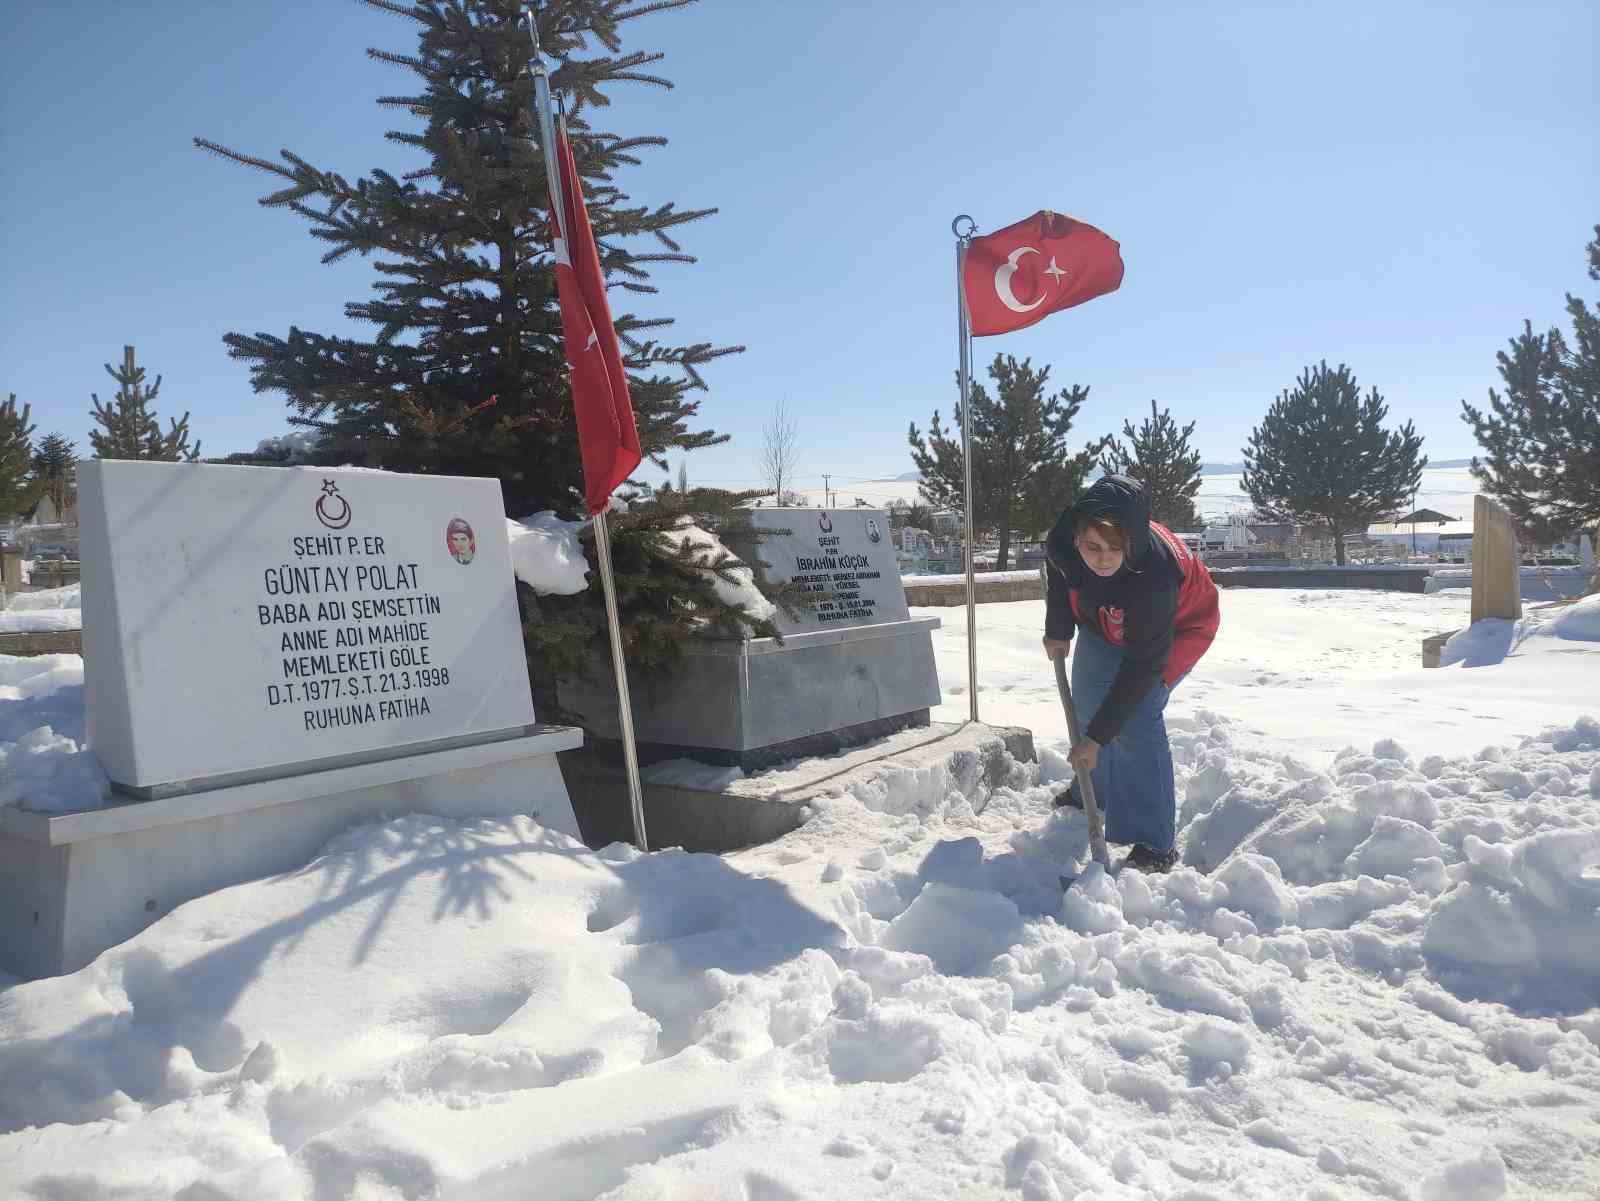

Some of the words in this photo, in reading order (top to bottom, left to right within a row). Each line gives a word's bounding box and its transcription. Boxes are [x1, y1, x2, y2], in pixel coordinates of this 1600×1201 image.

[293, 533, 342, 560] ŞEHİT
[796, 556, 837, 571] İBRAHİM
[264, 565, 349, 595] GÜNTAY
[356, 564, 418, 591] POLAT
[258, 603, 311, 625] BABA
[318, 601, 346, 621] ADI
[281, 629, 329, 652] ANNE
[368, 620, 430, 645] MAHİDE
[283, 647, 385, 678] MEMLEKETİ
[390, 645, 431, 668] GÖLE
[304, 703, 376, 730] RUHUNA
[379, 694, 431, 721] FATİHA
